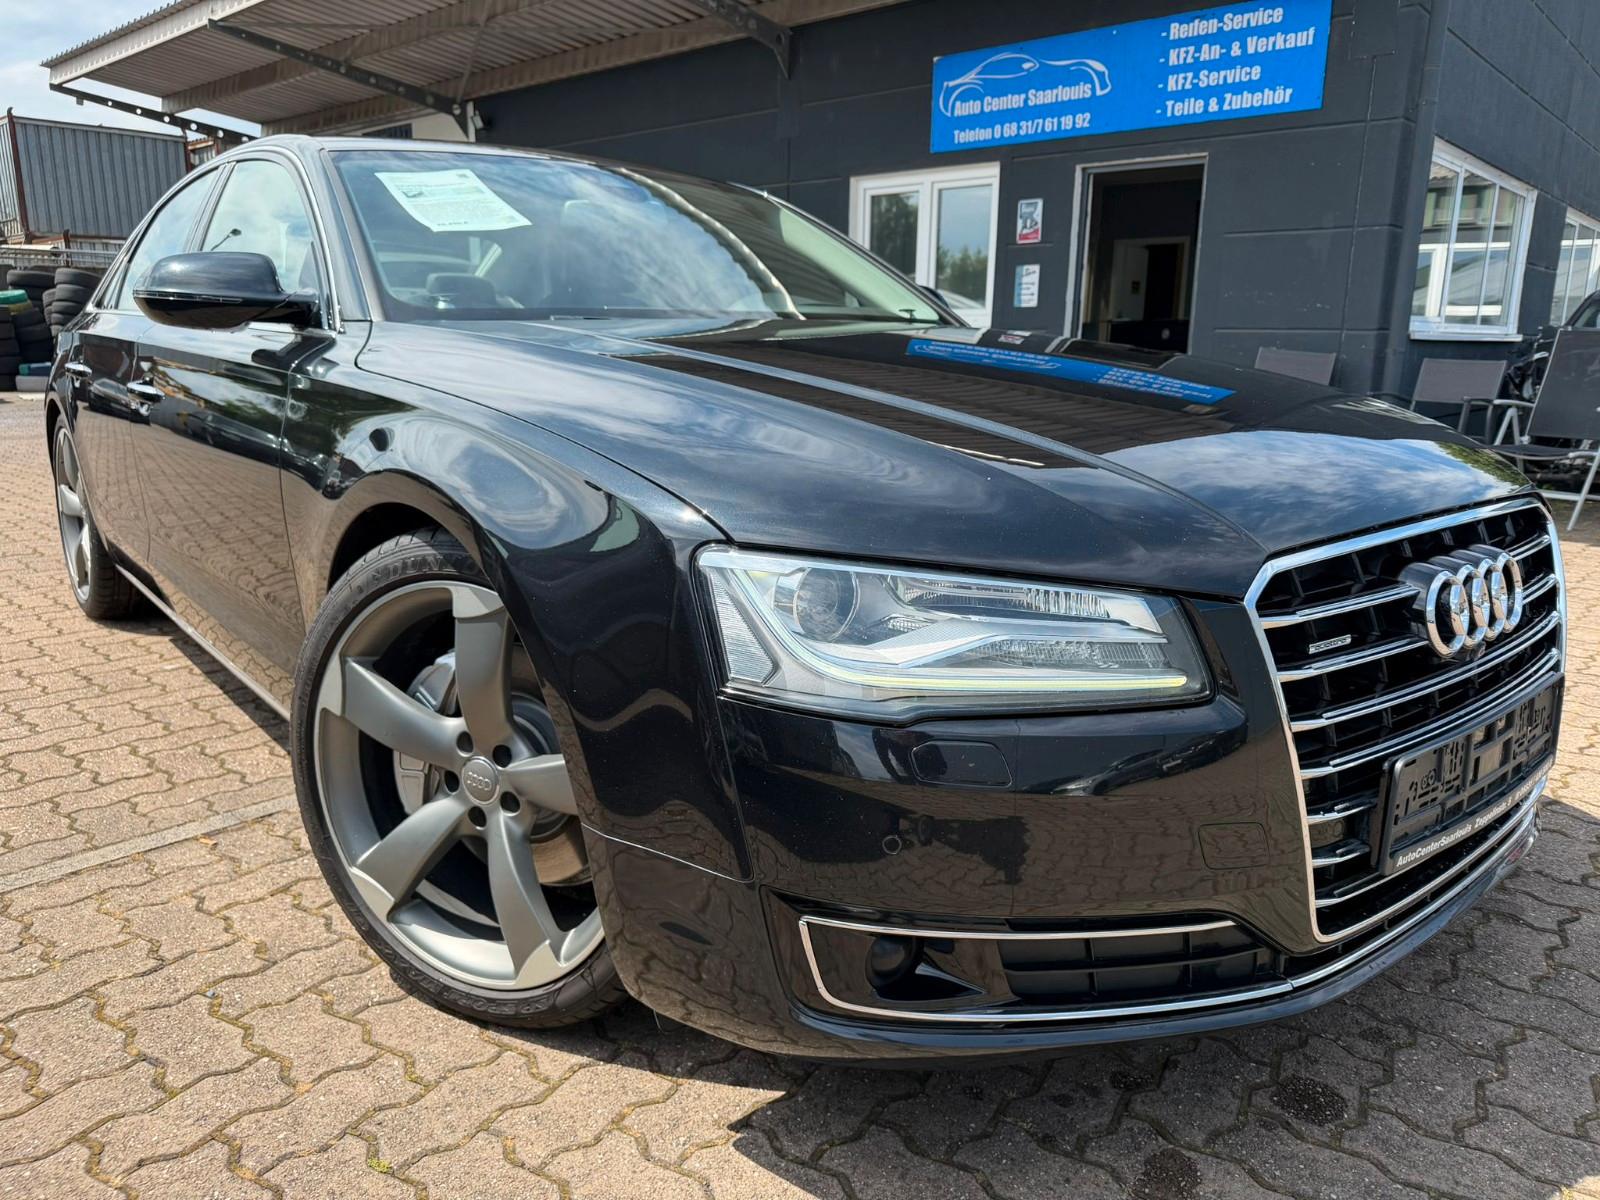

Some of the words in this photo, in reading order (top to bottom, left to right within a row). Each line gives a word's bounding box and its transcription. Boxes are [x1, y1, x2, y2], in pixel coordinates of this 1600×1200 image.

[1230, 41, 1242, 57] &
[1247, 26, 1316, 55] Verkauf
[954, 100, 982, 117] Auto
[983, 93, 1026, 113] Center
[1027, 82, 1092, 107] Saarlouis
[1165, 97, 1205, 118] Teile
[1208, 97, 1220, 113] &
[1222, 85, 1294, 111] Zubehör
[954, 126, 993, 144] Telefon
